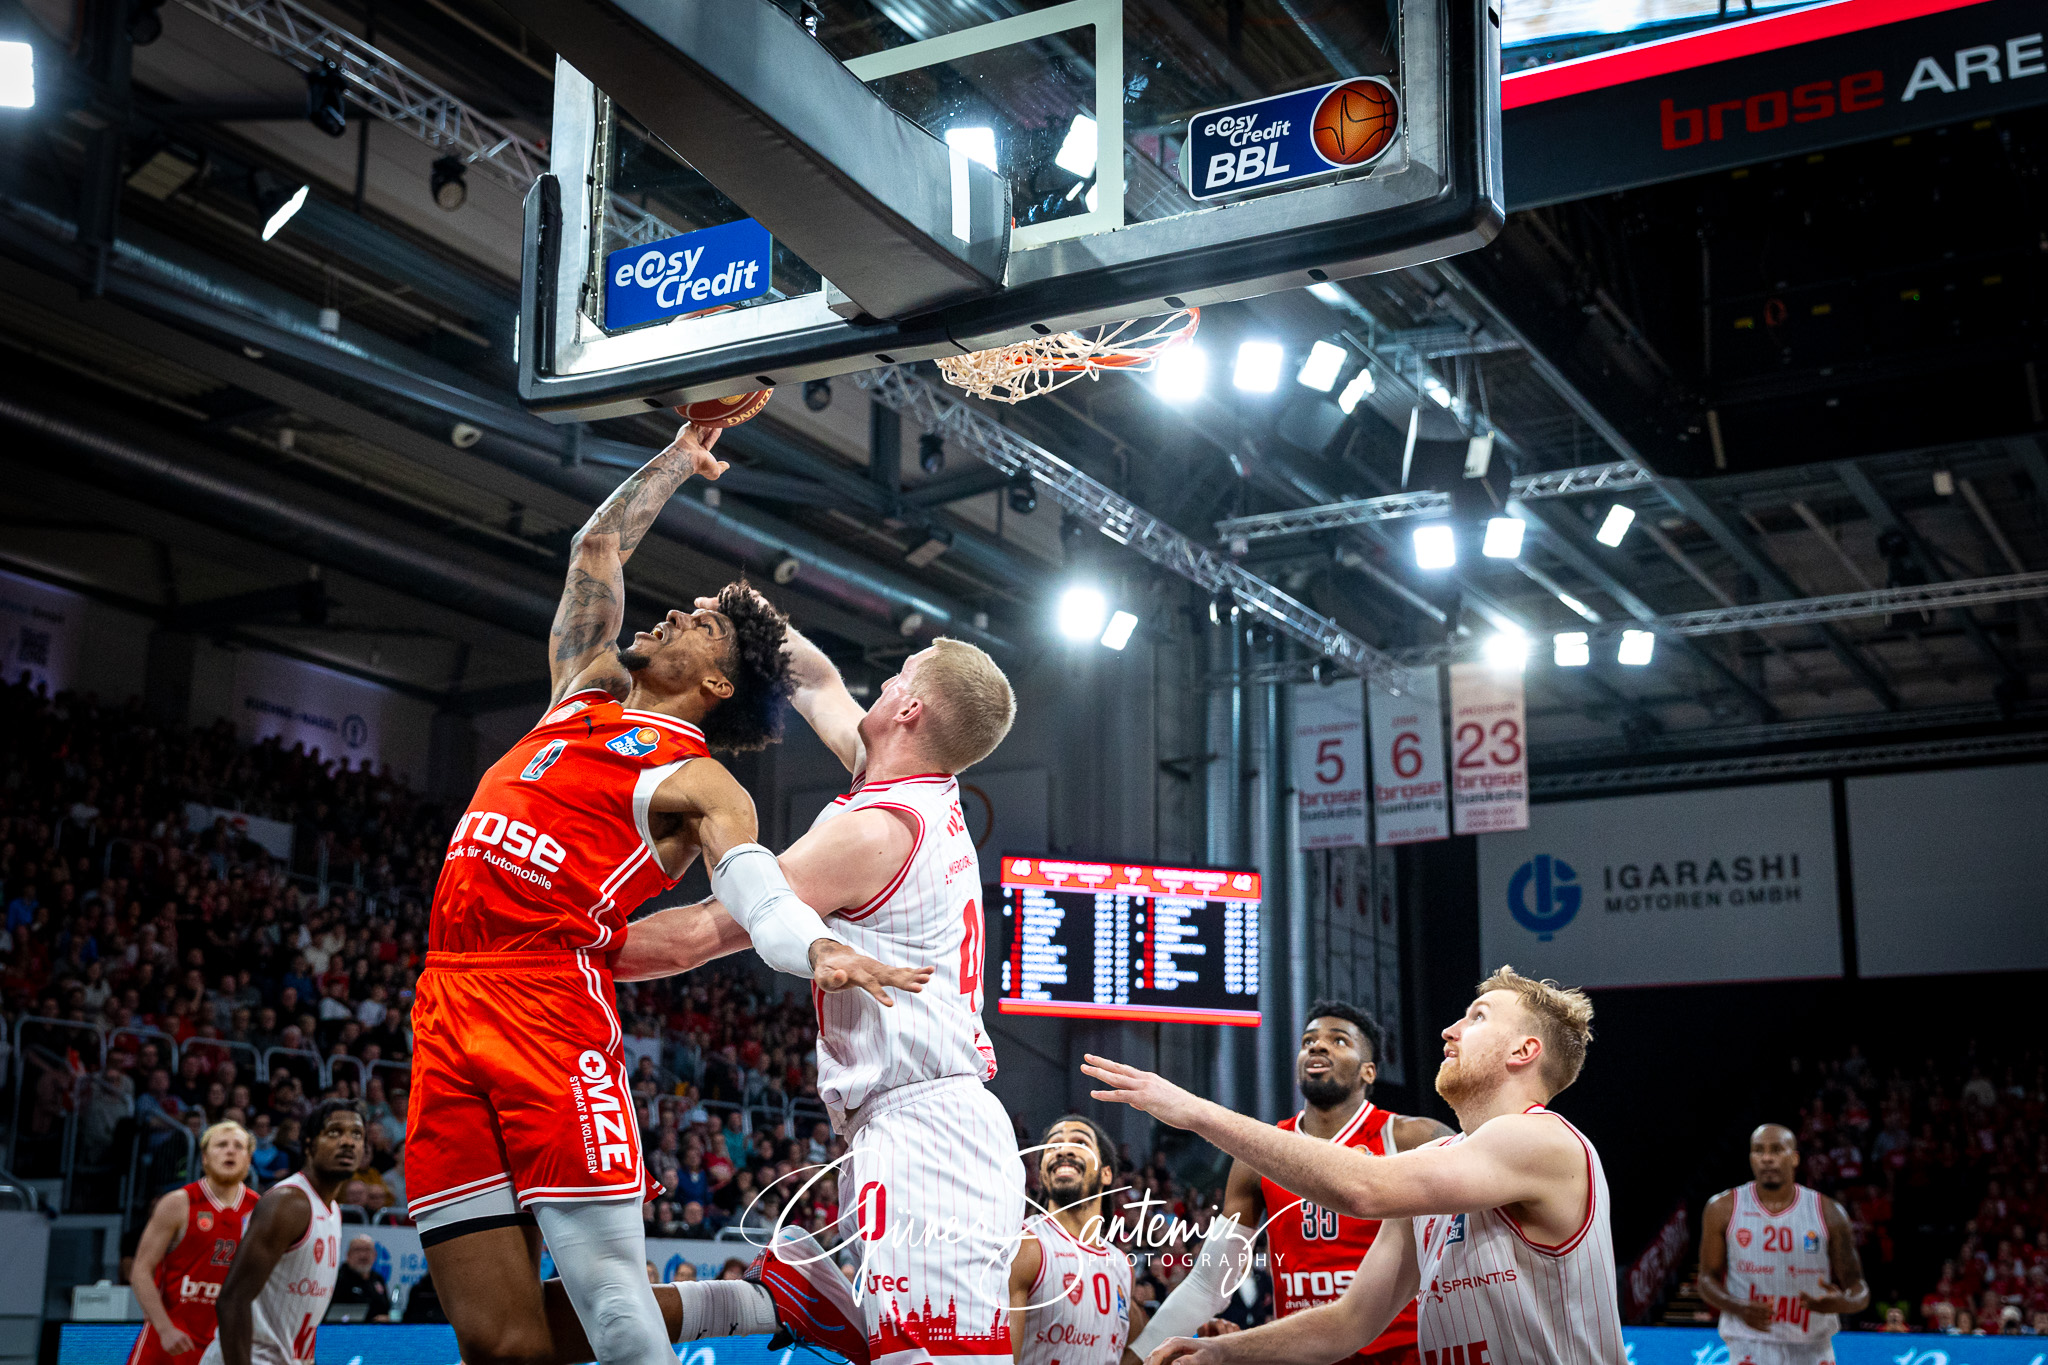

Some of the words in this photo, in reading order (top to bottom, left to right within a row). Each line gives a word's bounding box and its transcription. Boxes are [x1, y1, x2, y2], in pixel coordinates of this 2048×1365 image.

[1660, 70, 1884, 151] brose
[1901, 33, 2047, 102] ARE
[1230, 120, 1291, 146] Credit
[1205, 142, 1290, 189] BBL
[656, 260, 759, 308] Credit
[520, 739, 568, 781] 0
[1315, 738, 1345, 784] 5
[1391, 732, 1423, 779] 6
[1456, 719, 1521, 769] 23
[1298, 789, 1361, 807] brose
[1375, 781, 1442, 801] brose
[1454, 771, 1522, 789] brose
[482, 849, 552, 890] Automobile
[1602, 852, 1801, 892] IGARASHI
[1604, 892, 1721, 914] MOTOREN
[569, 1075, 588, 1113] STIRKAT
[581, 1122, 599, 1174] KOLLEGEN
[210, 1238, 237, 1266] 22
[1763, 1225, 1793, 1254] 20
[1092, 1272, 1111, 1315] 0
[1441, 1269, 1517, 1294] SPRINTIS
[1035, 1322, 1101, 1347] s.Oliver
